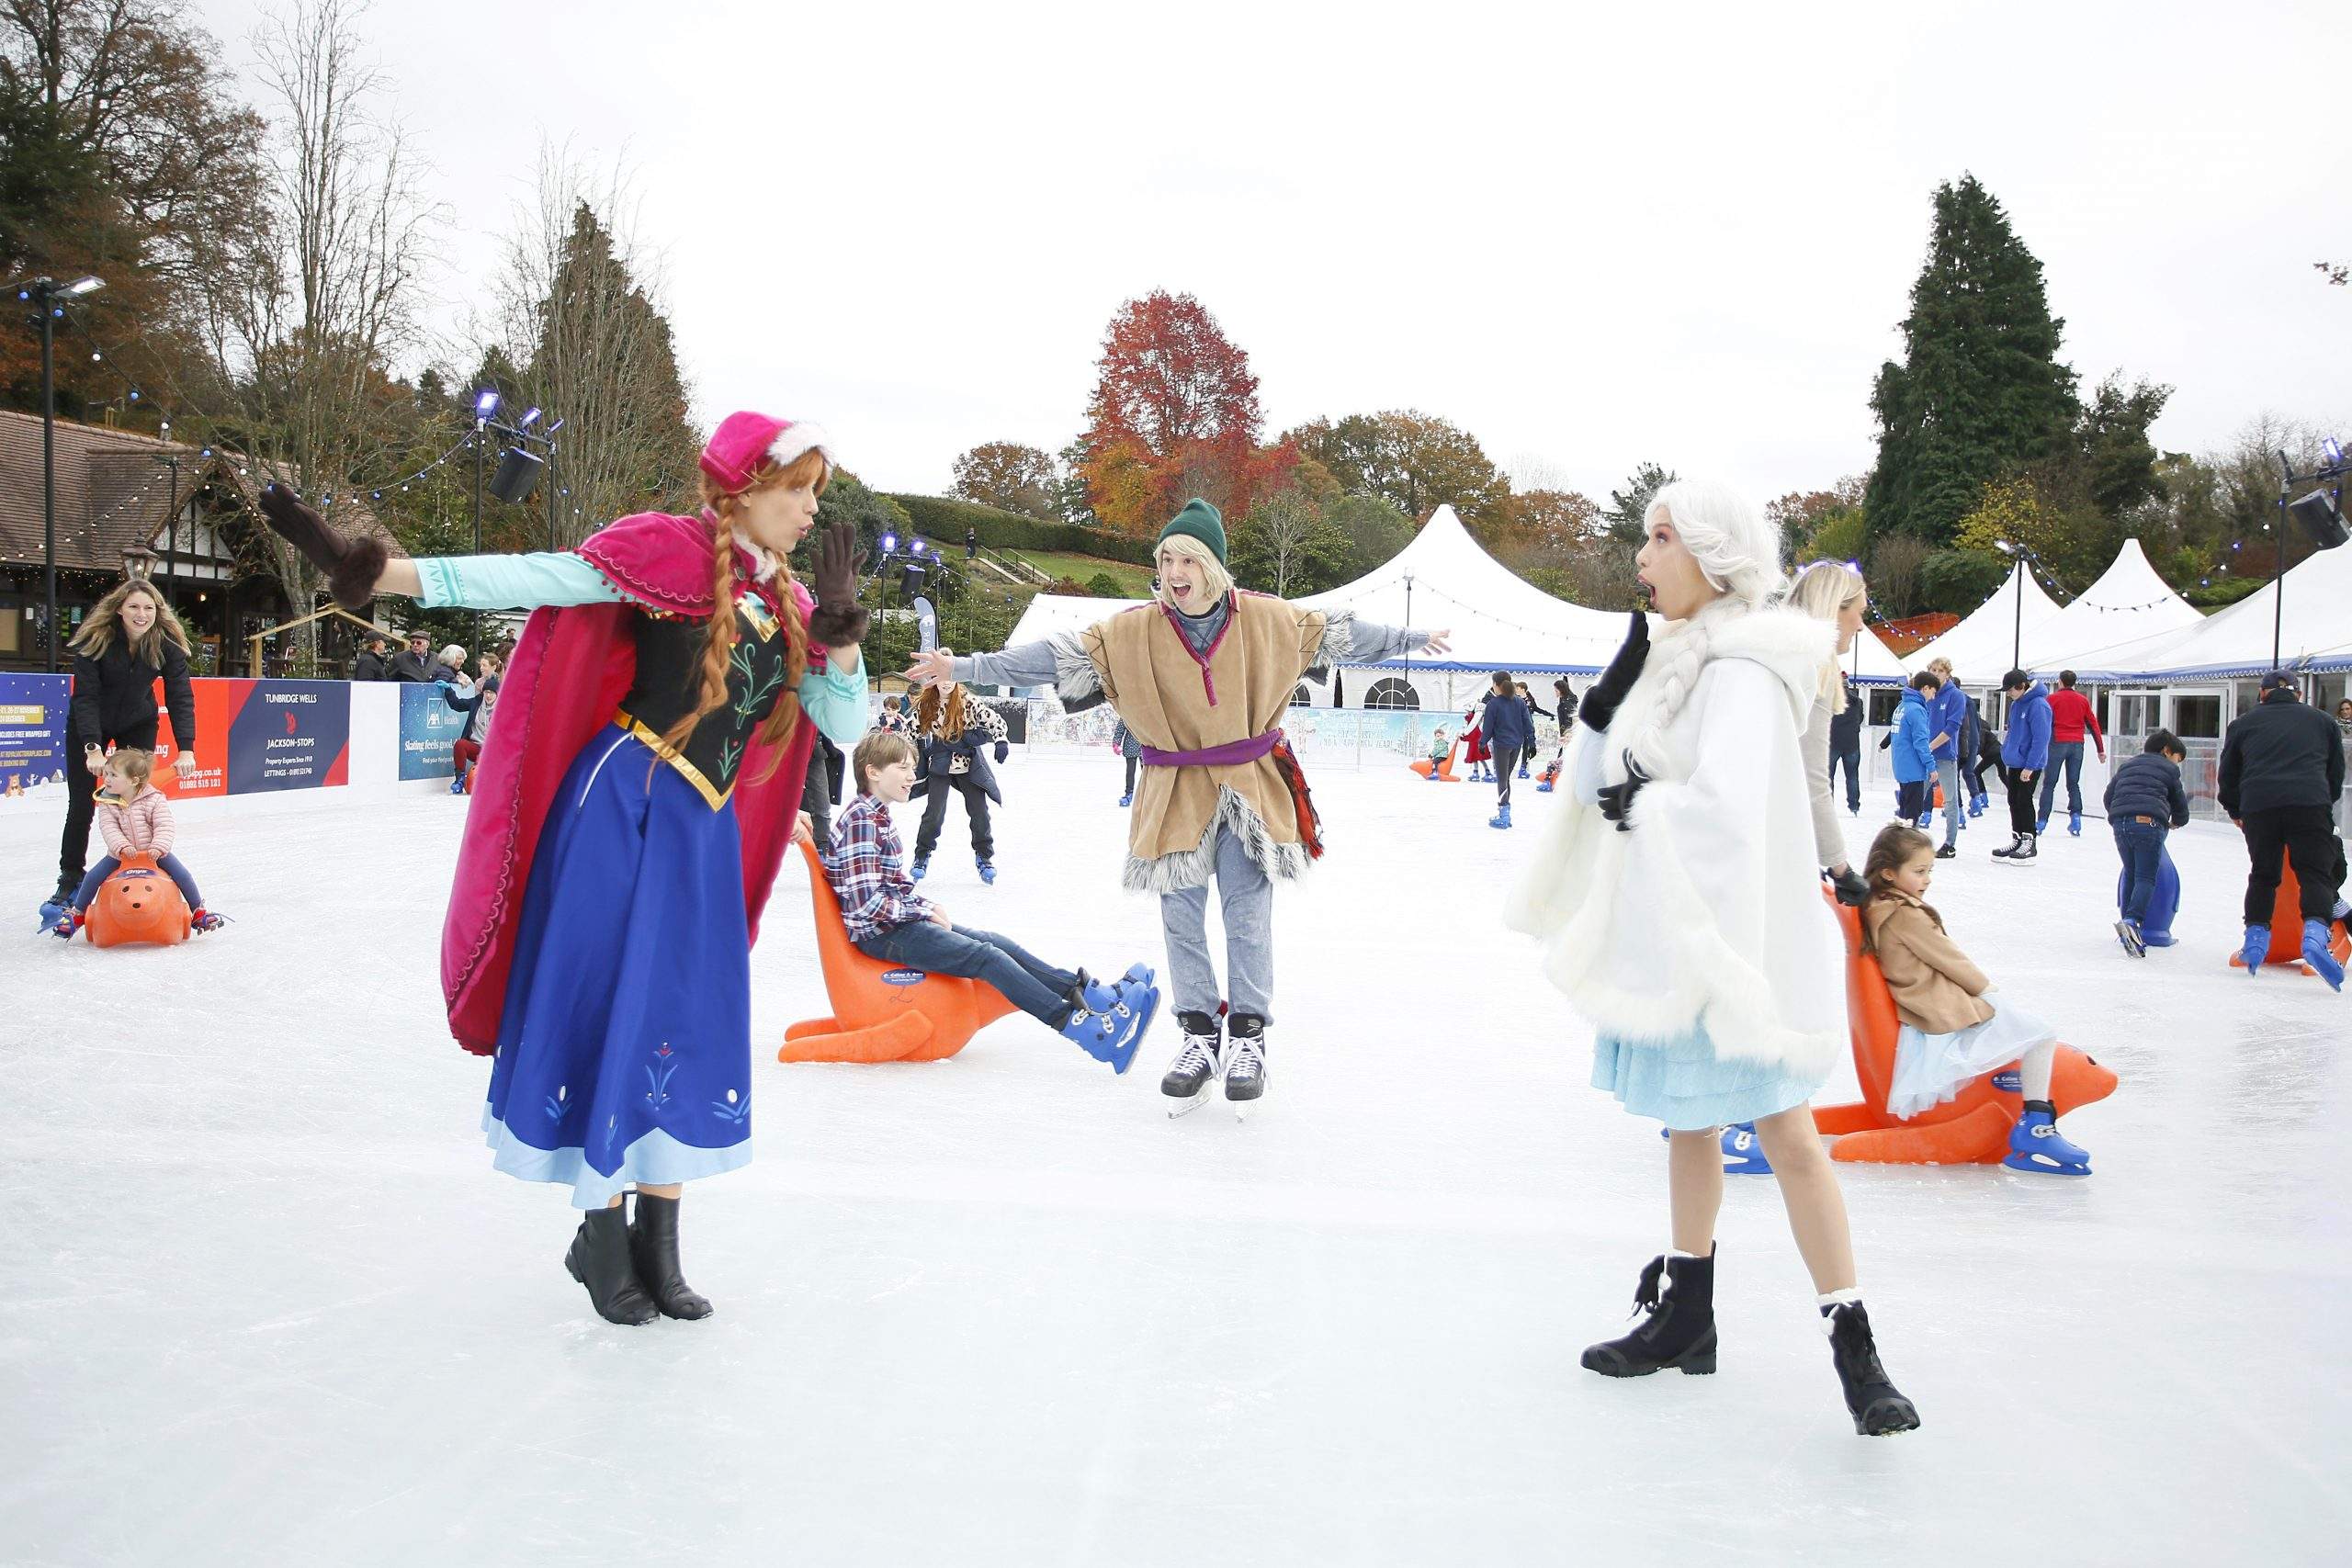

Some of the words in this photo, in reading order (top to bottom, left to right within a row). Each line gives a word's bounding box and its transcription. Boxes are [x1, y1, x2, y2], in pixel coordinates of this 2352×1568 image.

[266, 694, 299, 704] TUNBRIDGE
[300, 694, 317, 704] WELLS
[445, 716, 459, 725] Health
[266, 738, 315, 750] JACKSON-STOPS
[405, 739, 424, 752] Skating
[424, 739, 439, 750] feels
[266, 757, 282, 765] Property
